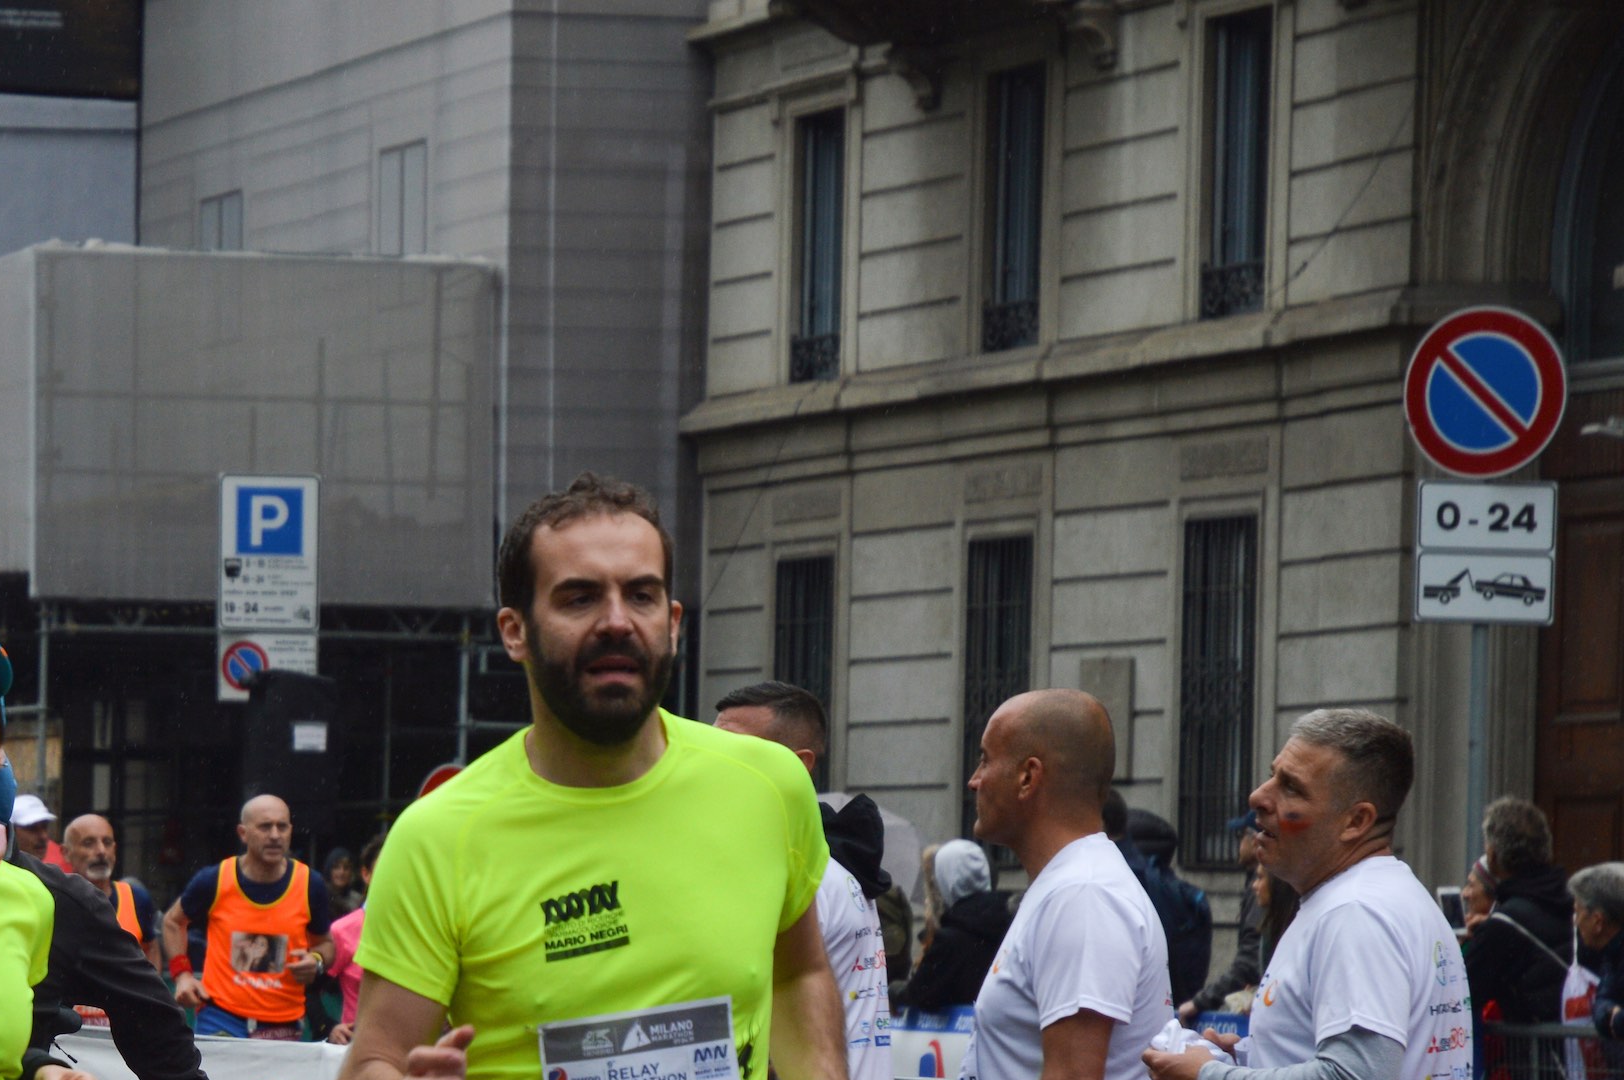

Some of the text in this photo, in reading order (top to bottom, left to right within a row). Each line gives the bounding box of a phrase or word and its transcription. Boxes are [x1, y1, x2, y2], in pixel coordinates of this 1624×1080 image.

[250, 494, 290, 547] P
[1436, 501, 1461, 531] 0
[1488, 502, 1538, 533] 24
[545, 924, 628, 950] MARIO NEGRI
[649, 1020, 693, 1033] MILANO
[608, 1062, 660, 1080] RELAY
